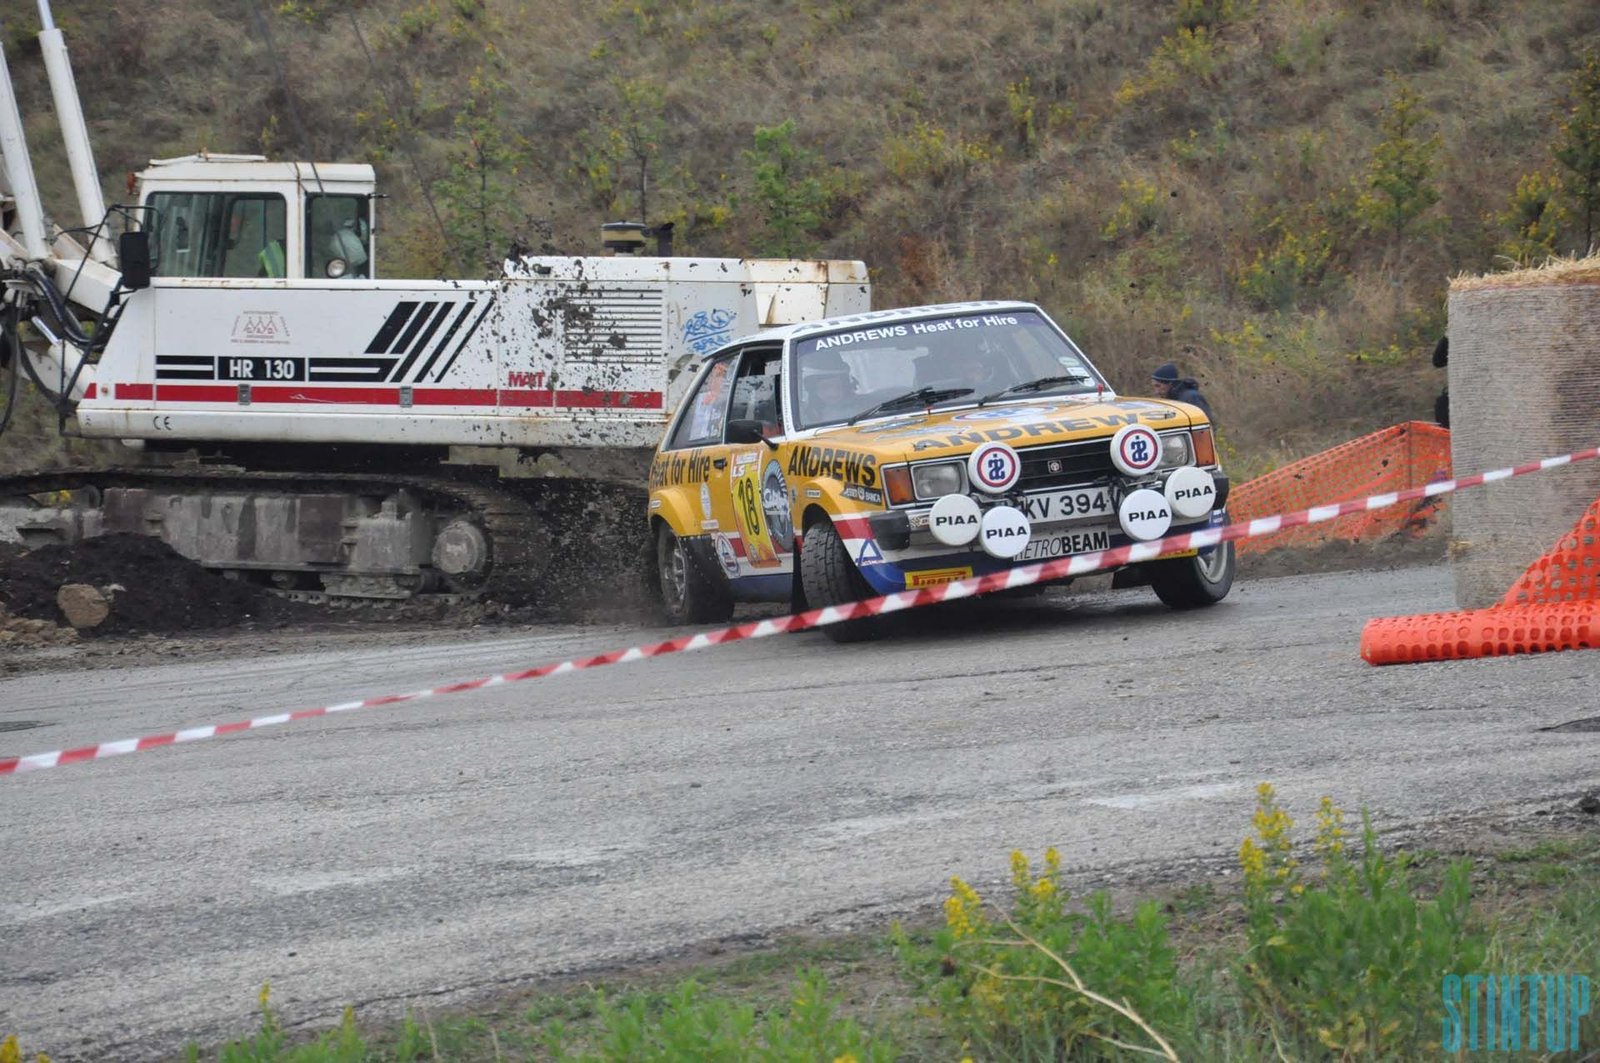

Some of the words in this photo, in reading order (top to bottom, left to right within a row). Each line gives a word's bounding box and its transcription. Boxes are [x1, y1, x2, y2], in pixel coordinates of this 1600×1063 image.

[815, 326, 908, 351] ANDREWS
[912, 320, 952, 335] Heat
[955, 316, 979, 329] for
[984, 314, 1018, 326] Hire
[229, 359, 254, 378] HR
[264, 360, 295, 379] 130
[913, 409, 1177, 451] ANDREWS
[671, 451, 686, 485] for
[688, 448, 710, 483] Hire
[787, 445, 877, 487] ANDREWS
[738, 478, 760, 535] 18
[1175, 486, 1213, 500] PIAA
[936, 514, 978, 526] PIAA
[1128, 508, 1169, 522] PIAA
[986, 526, 1027, 539] PIAA
[1015, 531, 1108, 560] ETROBEAM
